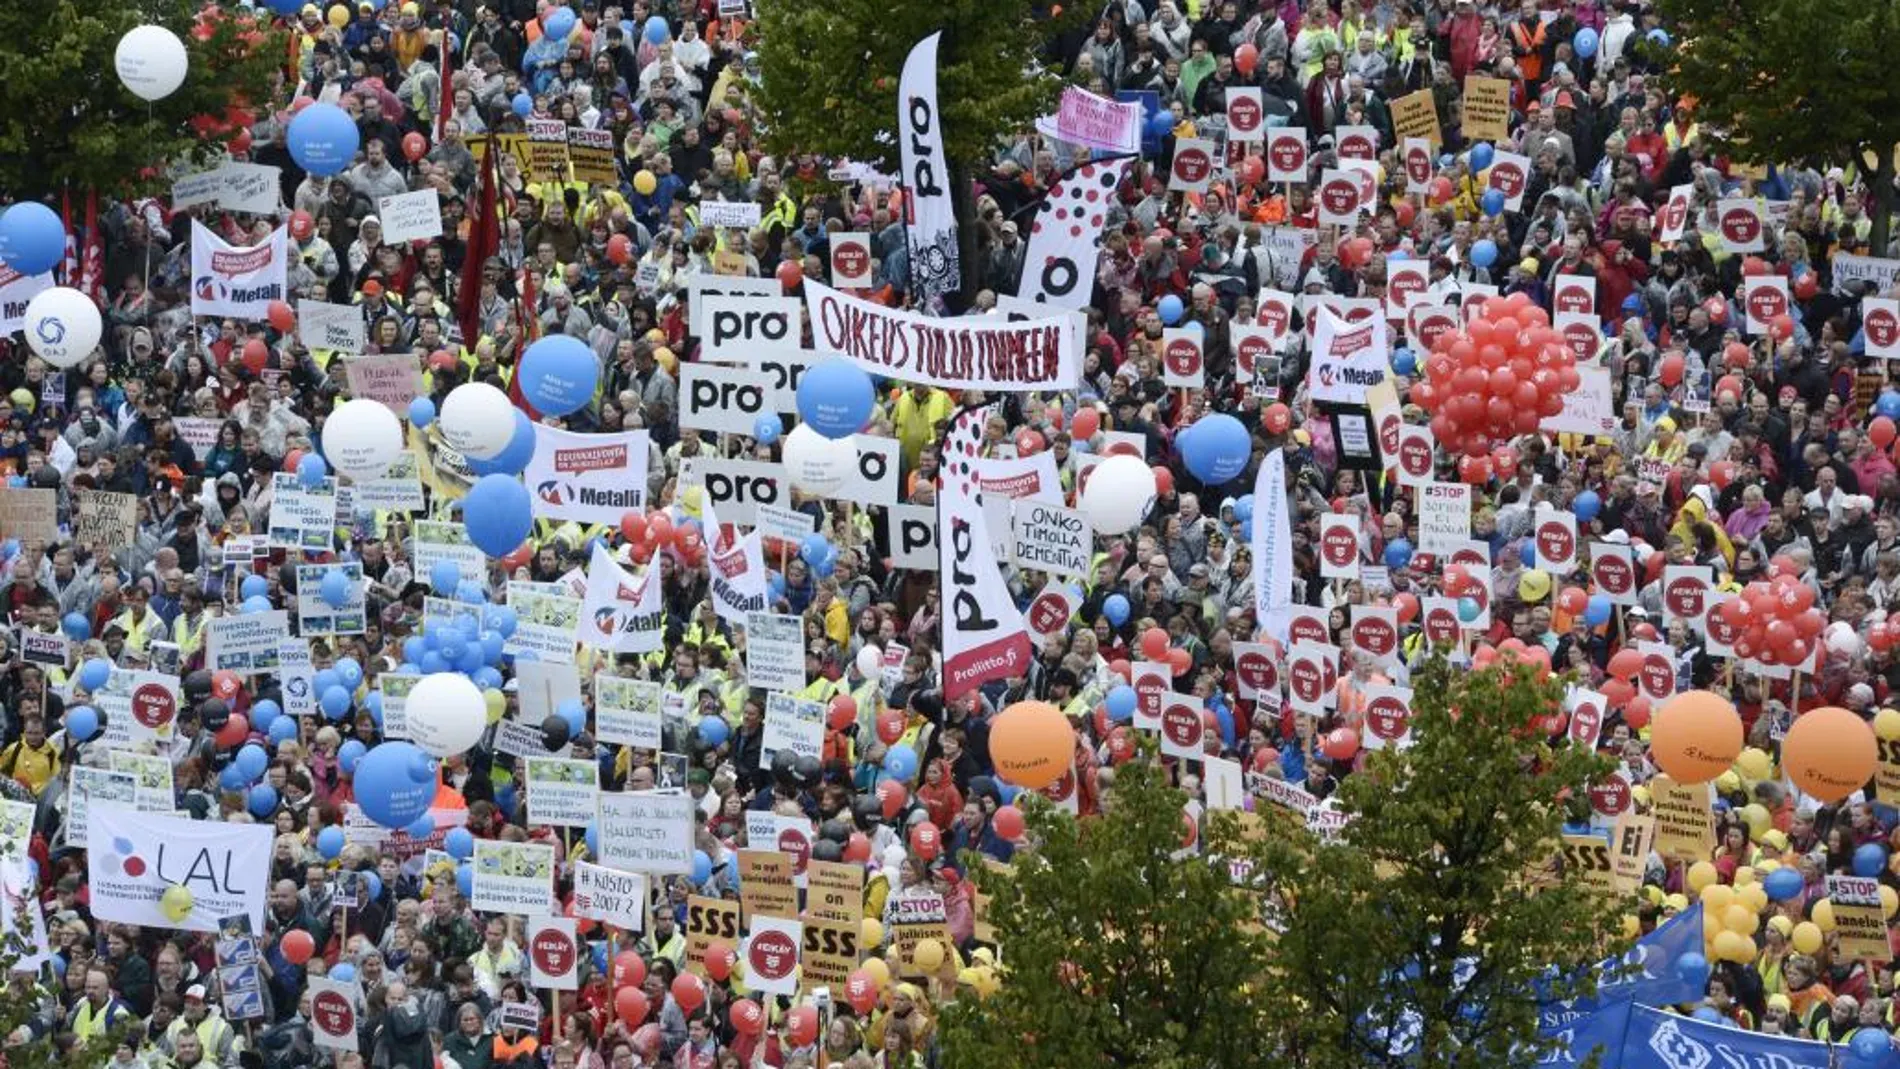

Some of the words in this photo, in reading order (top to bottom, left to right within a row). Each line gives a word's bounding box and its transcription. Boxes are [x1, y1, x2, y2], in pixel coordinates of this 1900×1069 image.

[914, 96, 942, 198] pro
[231, 283, 282, 304] Metalli
[714, 311, 788, 347] pro
[820, 295, 910, 369] OIKEUS
[911, 322, 975, 381] TULLA
[976, 325, 1060, 384] TOIMEEN
[1343, 368, 1385, 386] Metalli
[691, 379, 763, 415] pro
[580, 488, 642, 508] Metalli
[705, 472, 778, 507] pro
[1425, 487, 1465, 498] #STOP
[1022, 522, 1082, 548] TIMOLLA
[1032, 507, 1083, 532] ONKO
[1016, 541, 1087, 571] DEMENTIA?
[952, 515, 999, 632] pro
[712, 577, 765, 612] Metalli
[954, 649, 1018, 683] Proliitto.fi
[1621, 825, 1643, 857] Ei
[157, 842, 246, 896] LAL
[689, 905, 736, 939] SSS
[889, 899, 942, 913] #STOP
[804, 926, 856, 957] SSS
